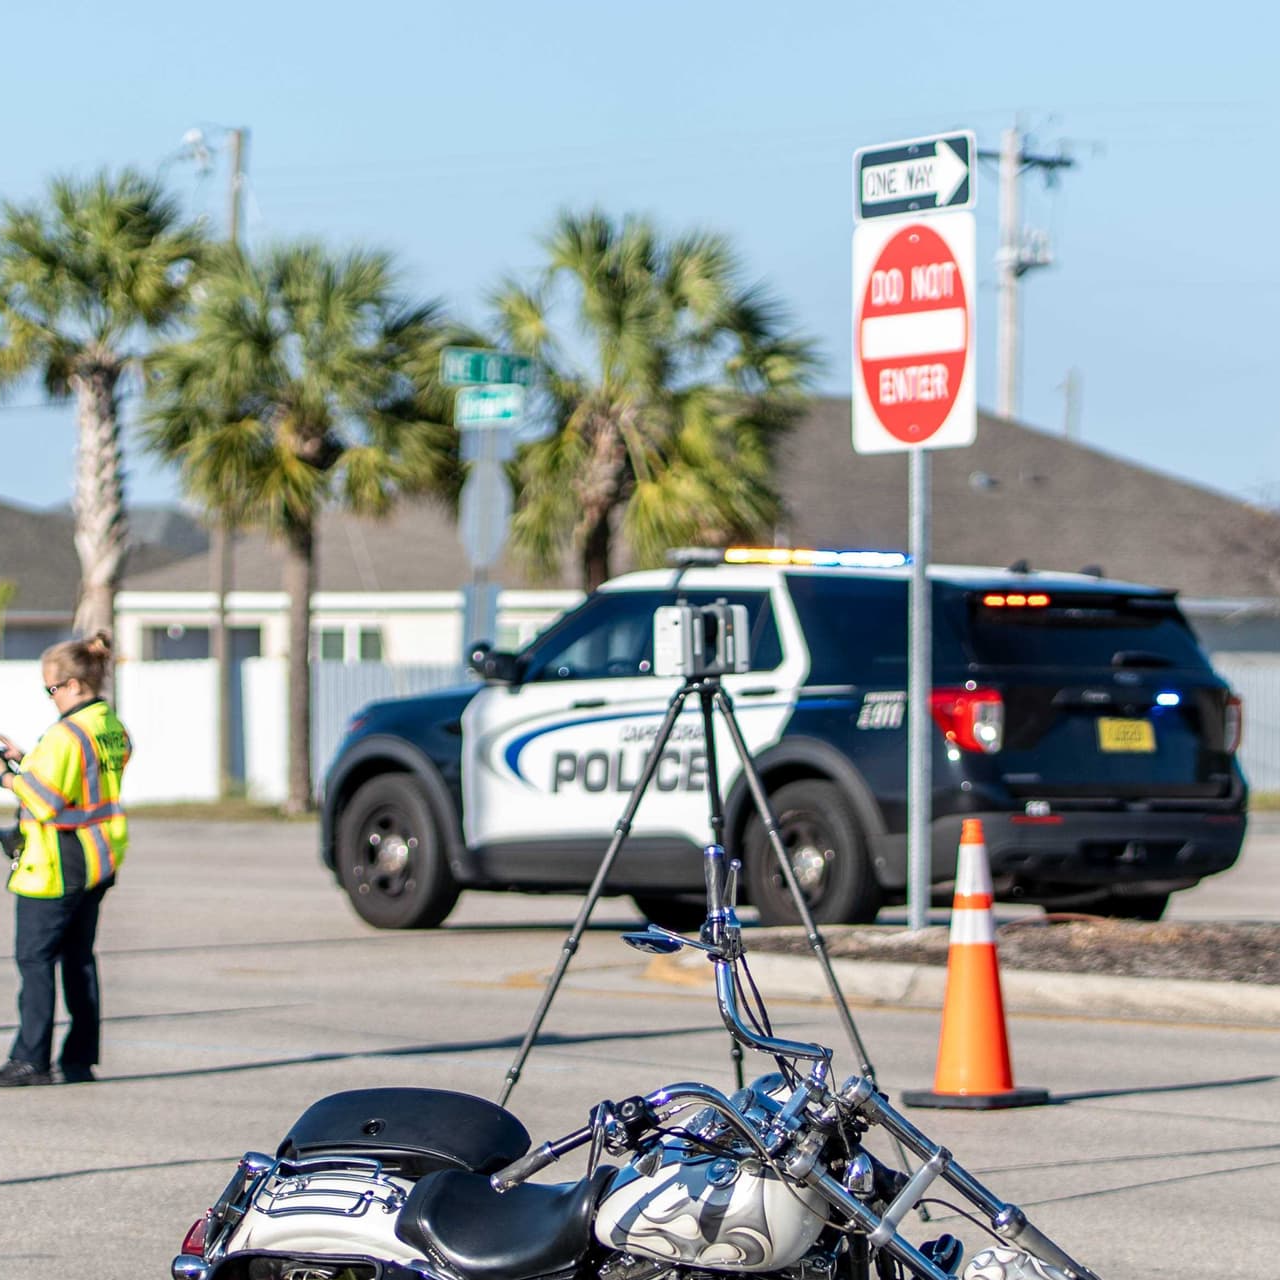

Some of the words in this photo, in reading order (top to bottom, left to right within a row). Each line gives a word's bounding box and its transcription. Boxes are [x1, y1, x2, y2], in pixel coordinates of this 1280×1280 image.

[865, 167, 897, 197] ONE
[905, 164, 933, 191] WAY
[871, 268, 904, 306] DO
[911, 261, 956, 301] NOT
[879, 363, 949, 406] ENTER
[552, 750, 708, 793] POLICE
